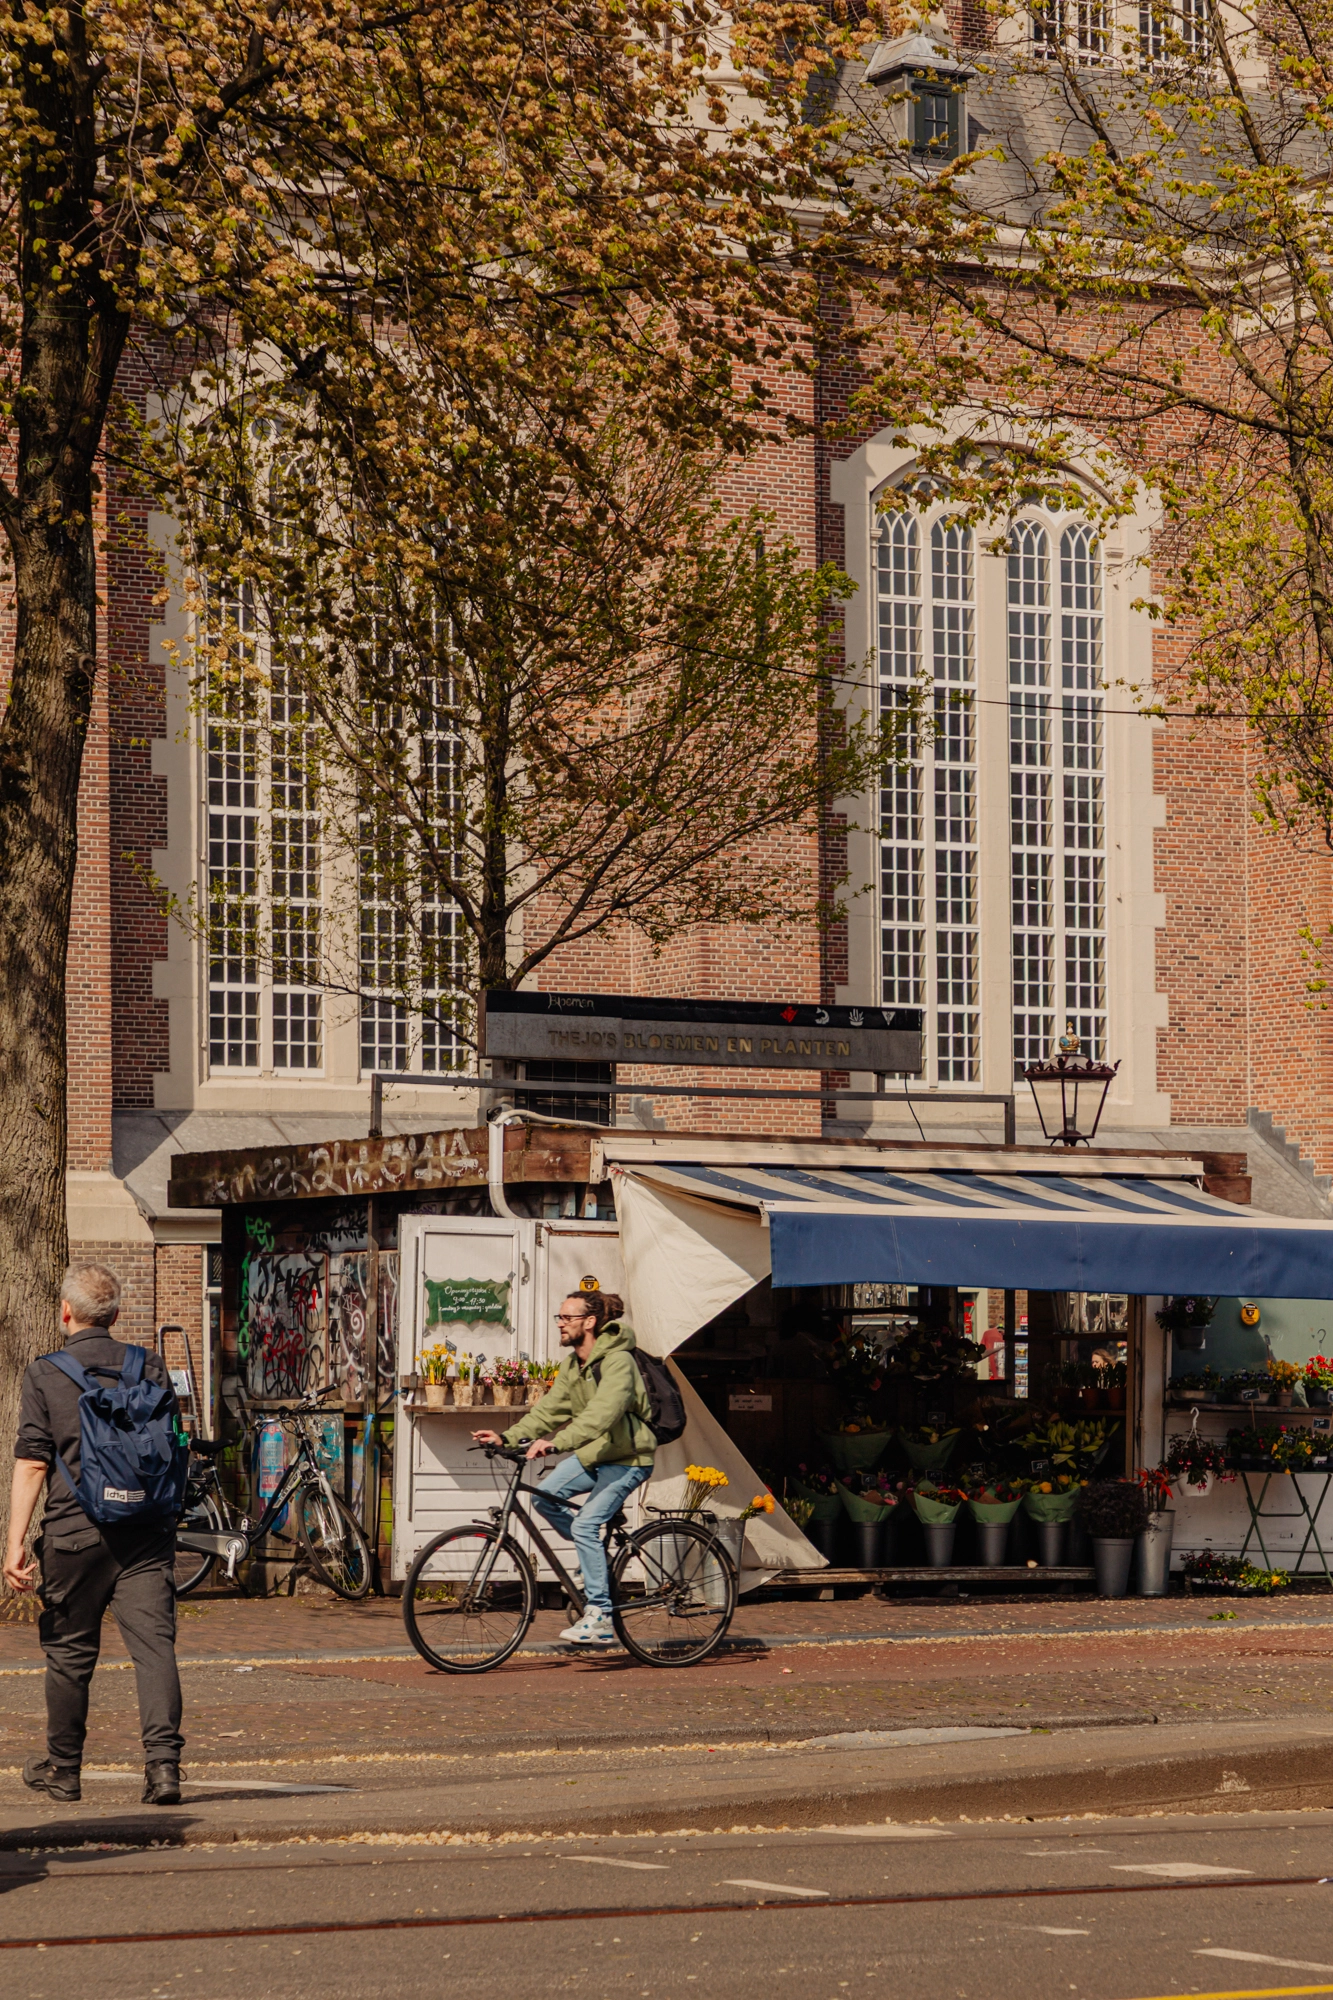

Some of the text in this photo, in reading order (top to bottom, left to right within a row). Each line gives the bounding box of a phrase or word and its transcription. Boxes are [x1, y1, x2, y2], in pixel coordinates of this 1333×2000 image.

[548, 1030, 850, 1056] THEJO'S BLOEMEN EN PLANTEN
